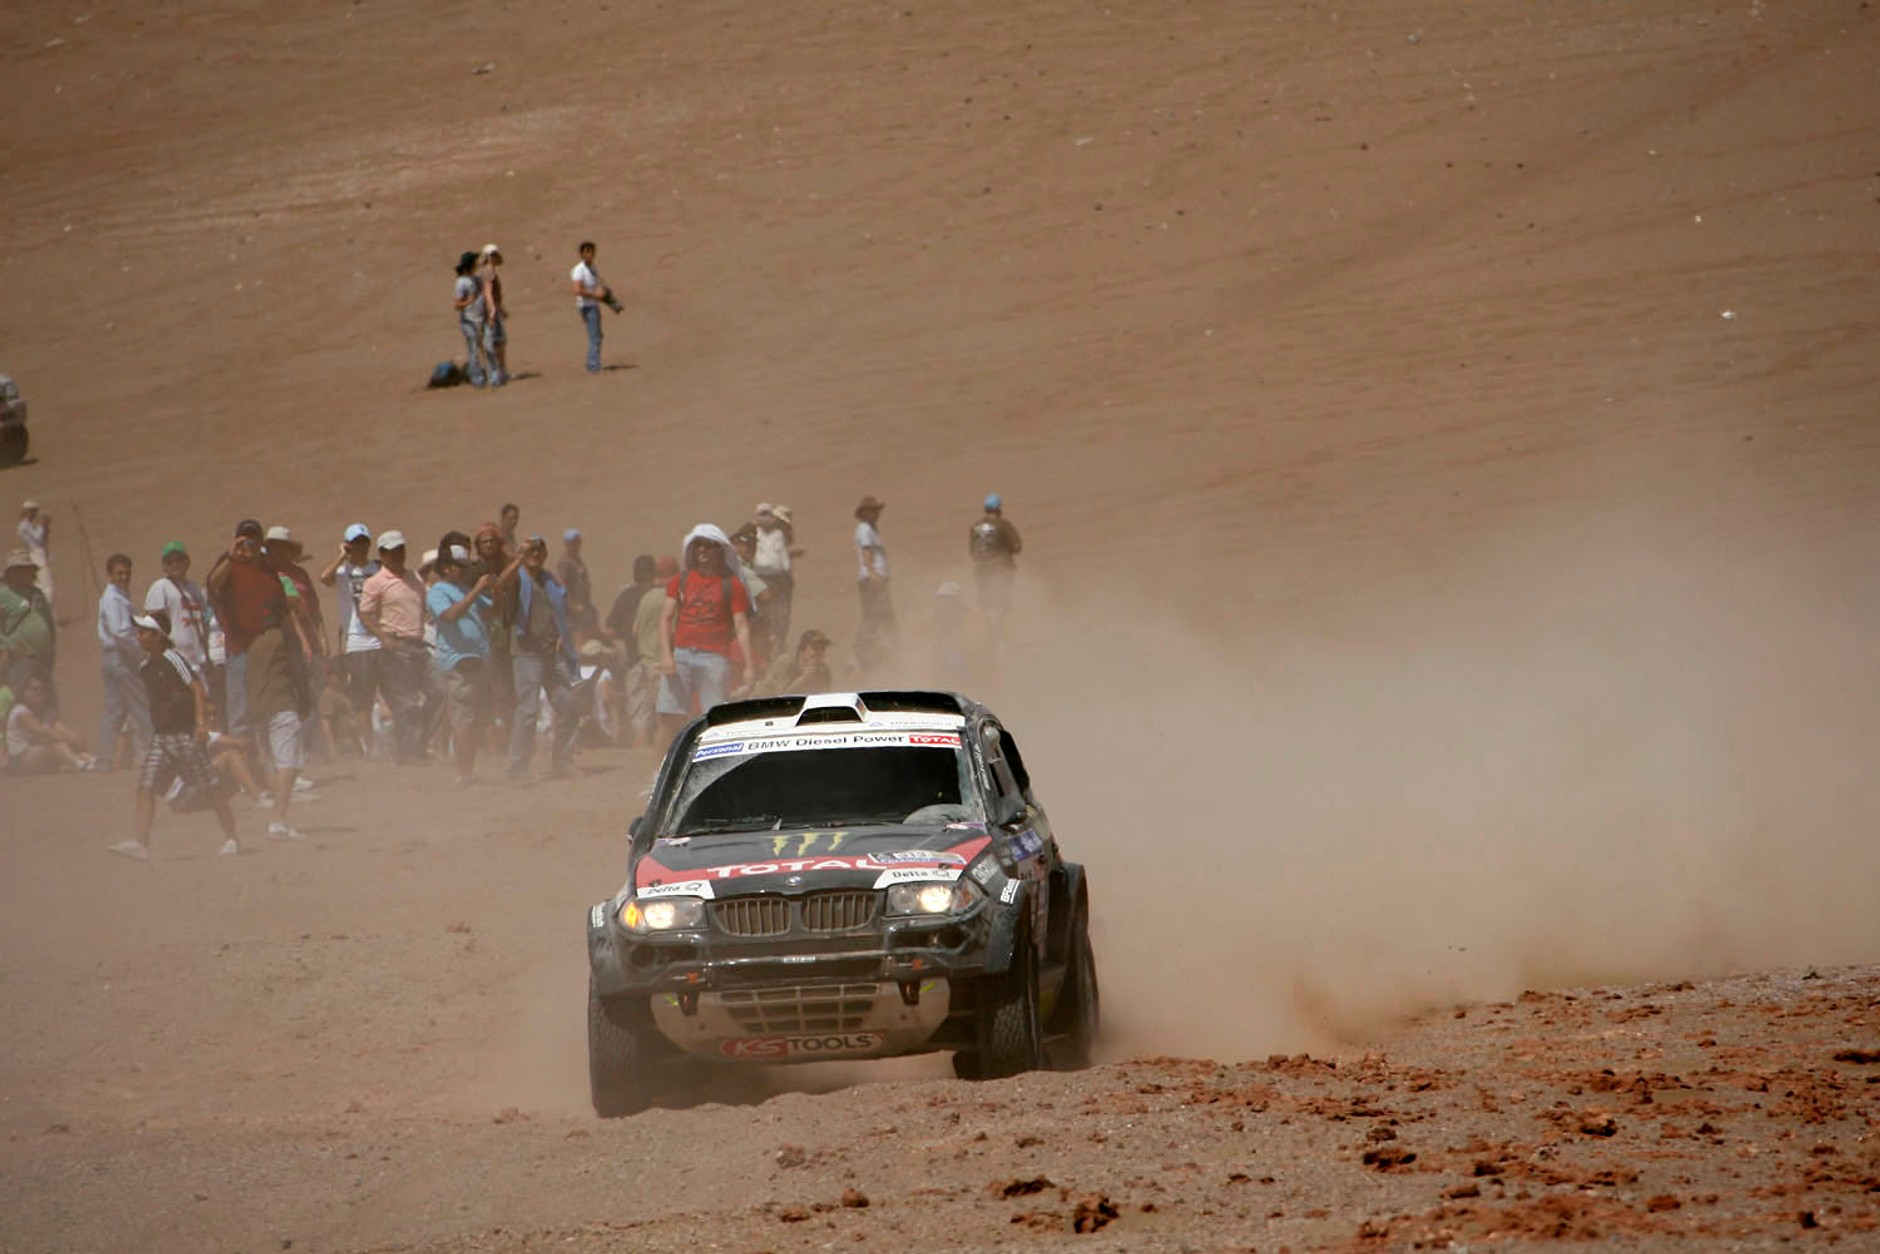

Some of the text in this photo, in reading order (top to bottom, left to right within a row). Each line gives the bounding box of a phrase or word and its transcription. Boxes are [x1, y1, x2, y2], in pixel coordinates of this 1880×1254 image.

[748, 735, 904, 750] BMW Diesel Power
[911, 735, 960, 745] TOTAL
[695, 744, 742, 758] Personal
[707, 860, 887, 878] TOTAL
[647, 886, 681, 895] Delta
[733, 1036, 872, 1055] KS TOOLS
